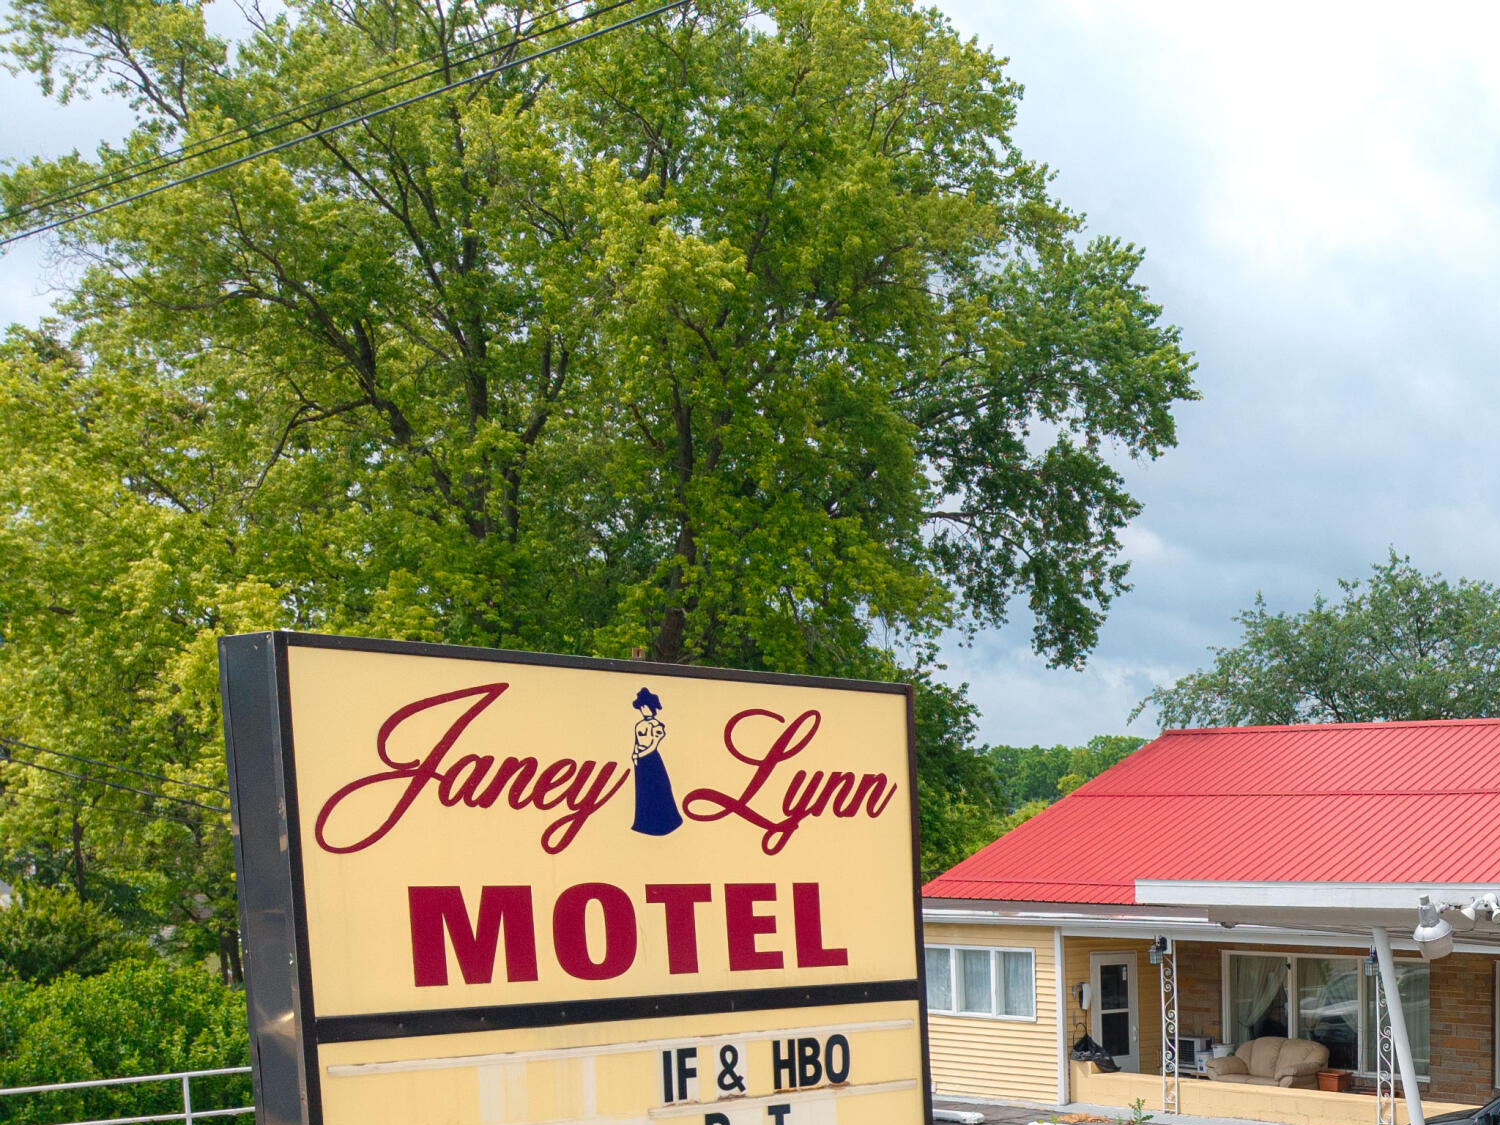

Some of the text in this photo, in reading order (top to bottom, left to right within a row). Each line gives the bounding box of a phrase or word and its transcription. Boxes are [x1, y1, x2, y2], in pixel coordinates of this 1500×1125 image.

[315, 682, 897, 857] Janey Lynn
[408, 881, 849, 988] MOTEL
[662, 1034, 850, 1102] IF & HBO
